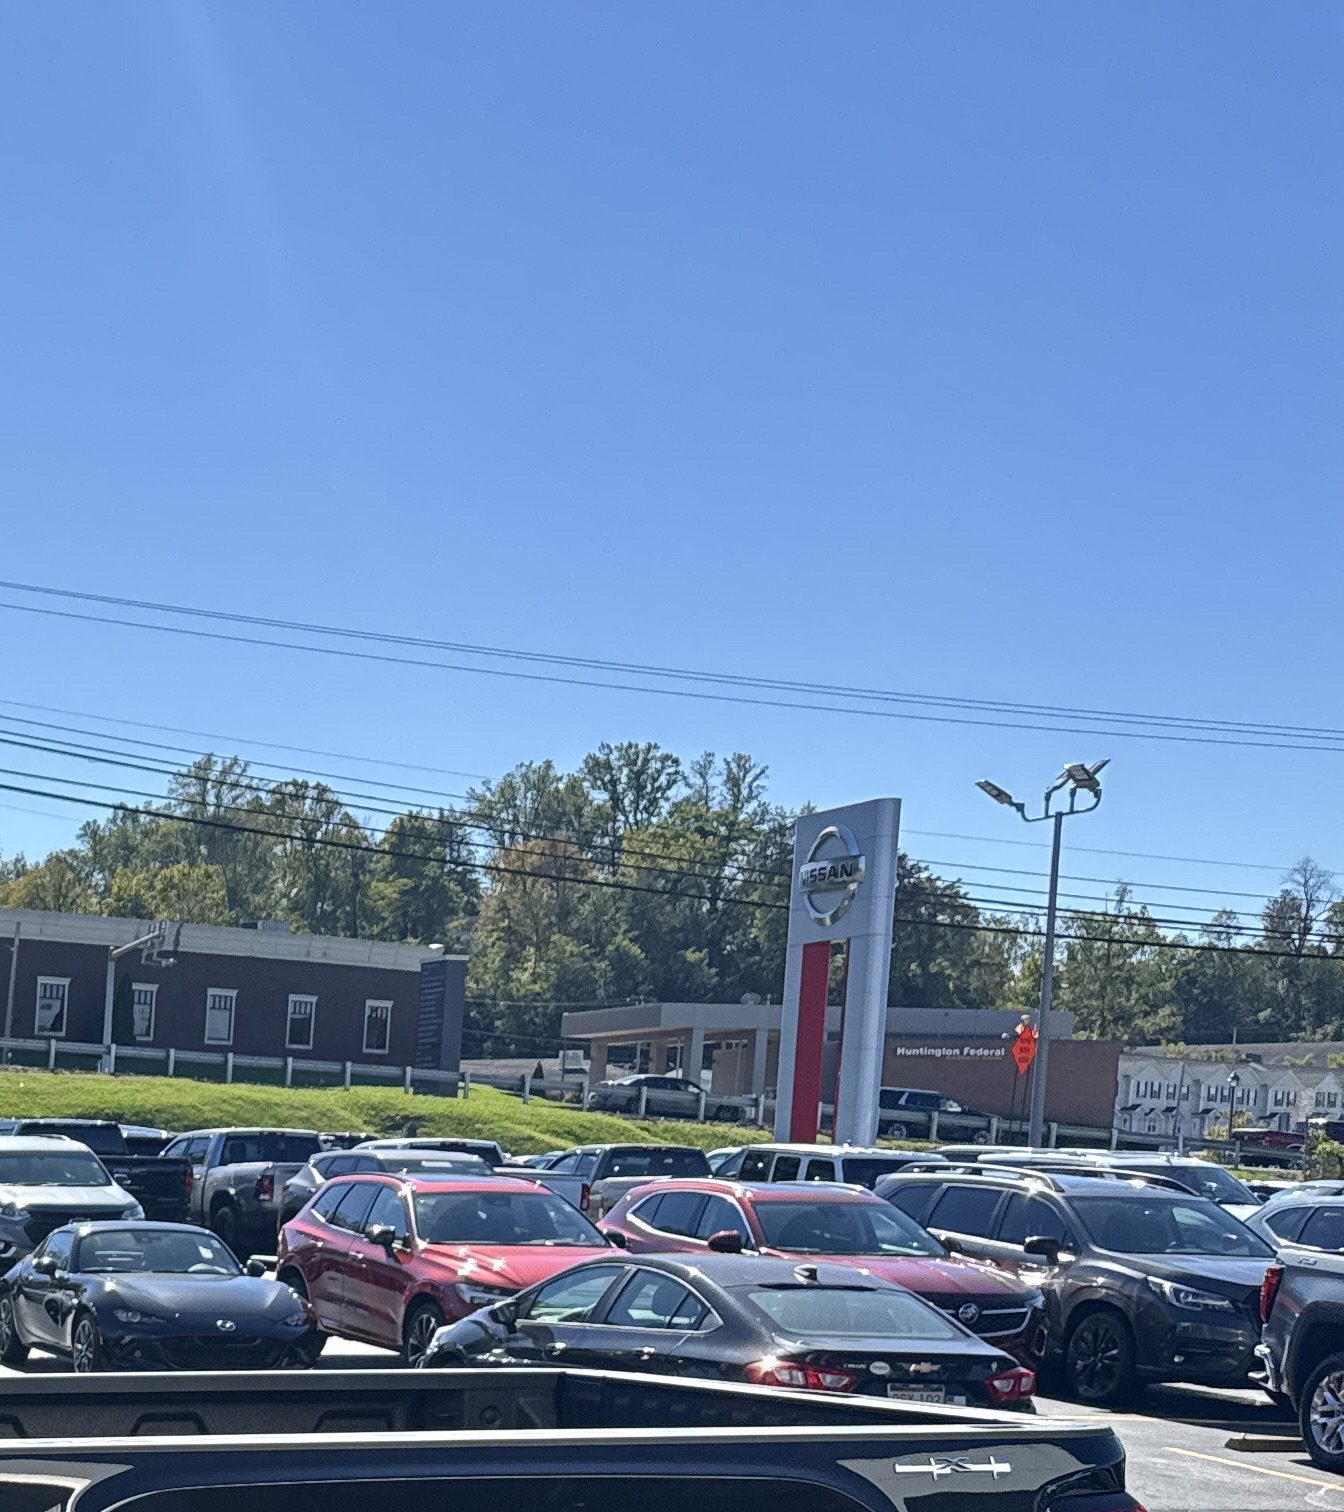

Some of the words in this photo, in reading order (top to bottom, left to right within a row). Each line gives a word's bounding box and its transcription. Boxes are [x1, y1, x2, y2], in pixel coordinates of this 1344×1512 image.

[800, 862, 853, 885] NISSAN
[896, 1047, 960, 1058] Huntington
[963, 1047, 1005, 1056] Federal
